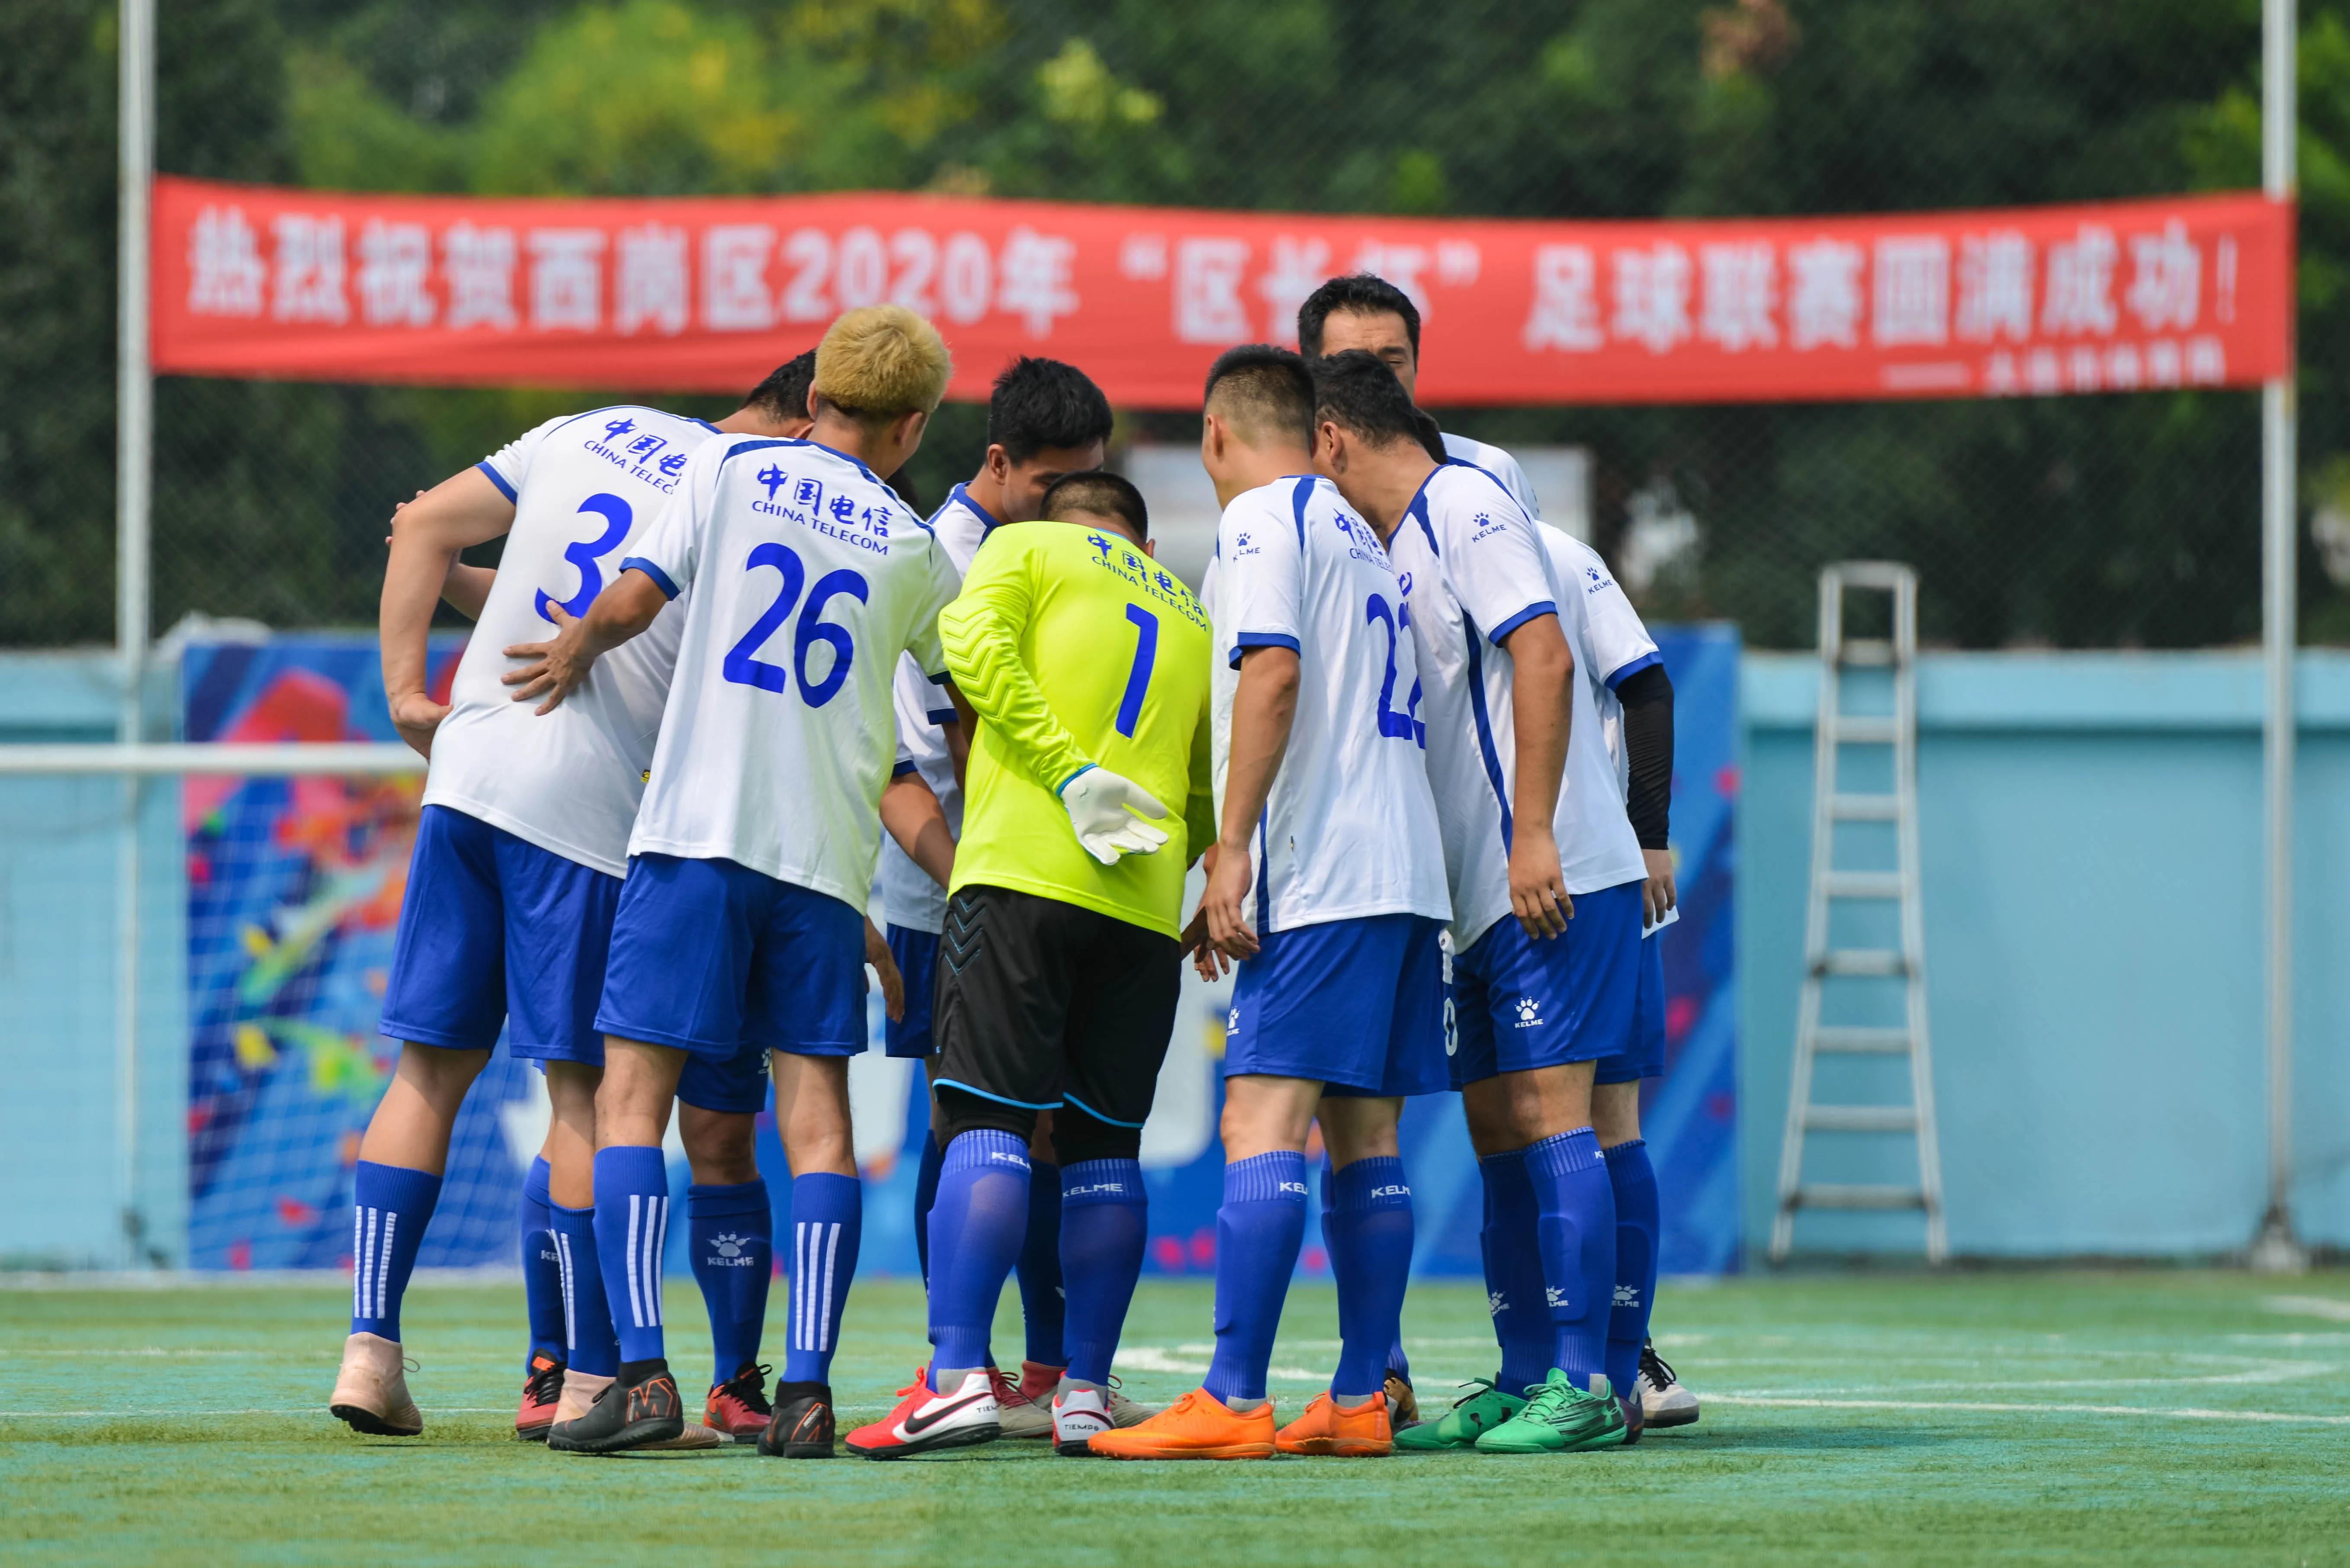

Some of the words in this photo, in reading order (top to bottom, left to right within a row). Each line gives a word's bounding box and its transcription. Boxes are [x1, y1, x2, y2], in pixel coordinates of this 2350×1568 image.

[584, 440, 626, 468] CHINA
[630, 465, 673, 494] TELEC
[603, 418, 687, 485] 中国电
[757, 463, 893, 537] 中国电信
[752, 501, 805, 525] CHINA
[811, 518, 888, 555] TELECOM
[1233, 547, 1260, 562] KLME
[1472, 524, 1506, 542] KELME
[535, 493, 632, 624] 3
[1087, 533, 1204, 618] 中国电信
[1092, 556, 1138, 586] CHINA
[1142, 582, 1207, 632] TELECOM
[1588, 580, 1613, 594] KELME
[723, 542, 869, 709] 26
[1115, 603, 1159, 739] 1
[1515, 1019, 1544, 1028] KELME
[1063, 1183, 1124, 1199] KELME
[707, 1257, 754, 1267] KELME
